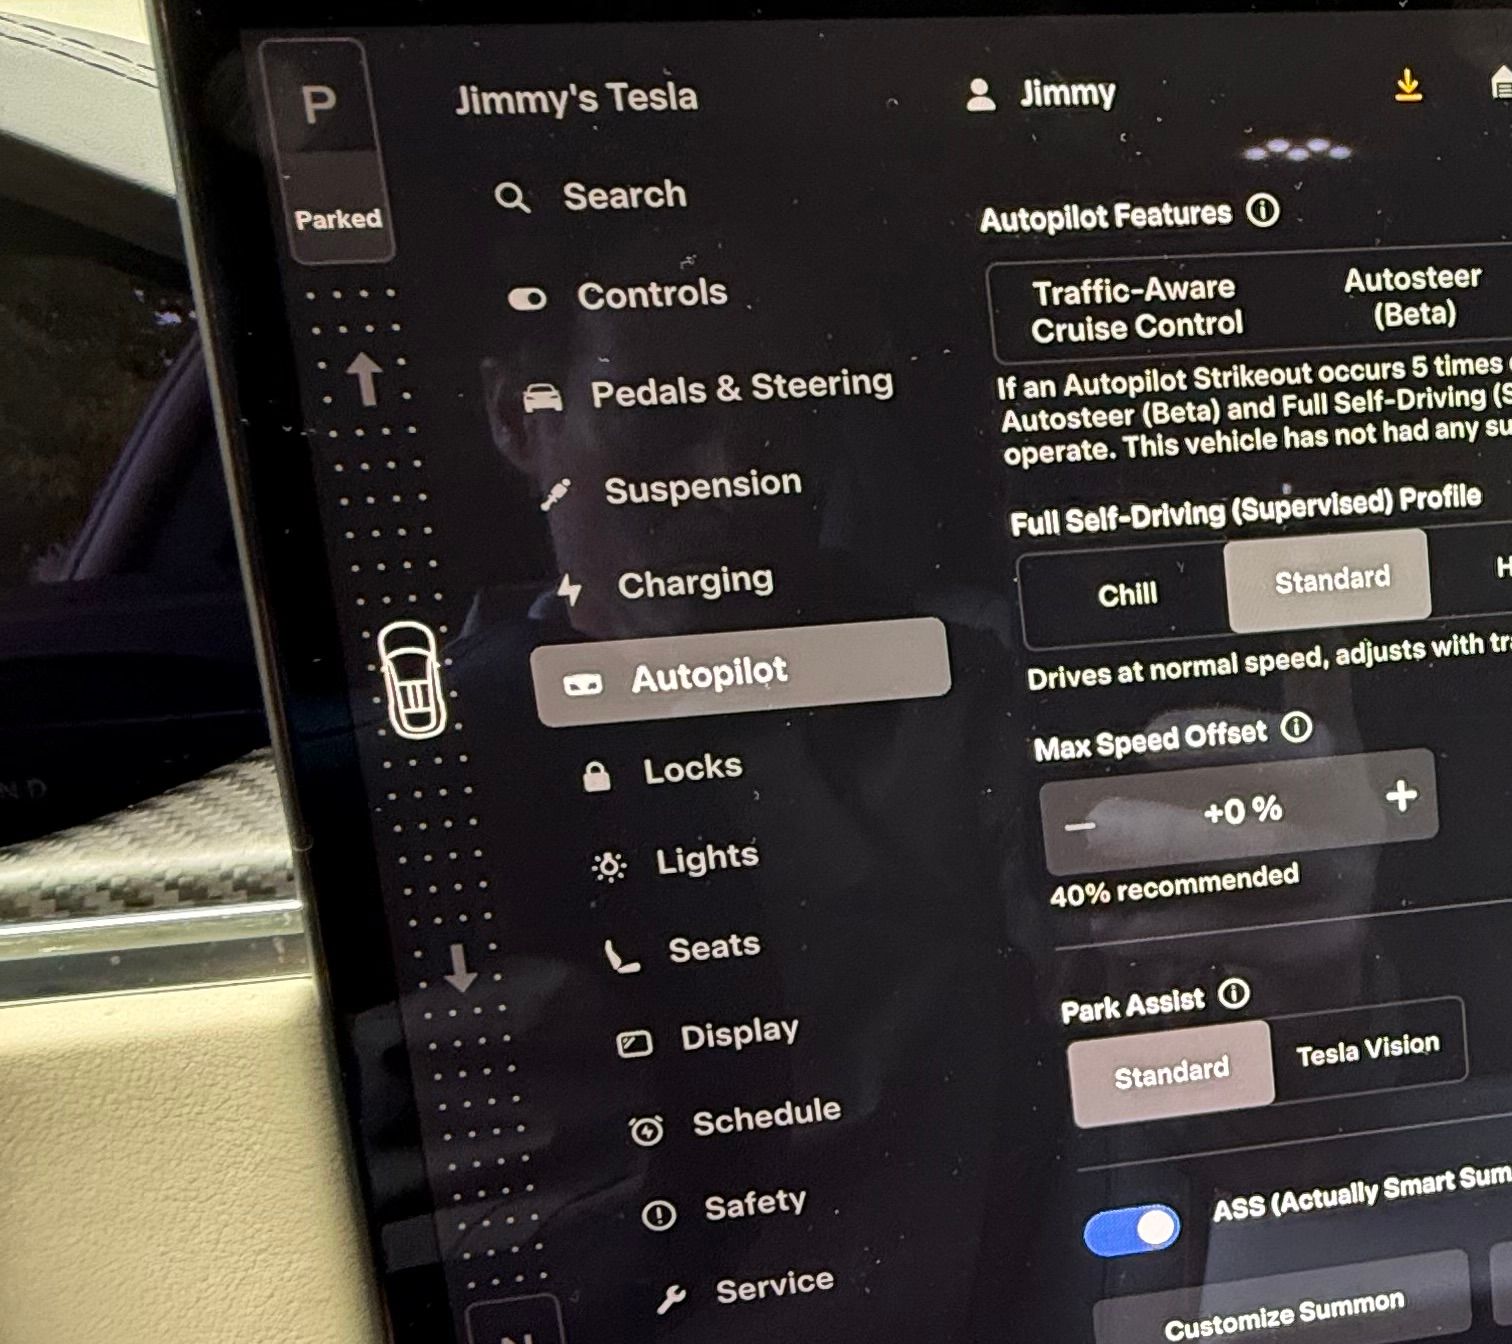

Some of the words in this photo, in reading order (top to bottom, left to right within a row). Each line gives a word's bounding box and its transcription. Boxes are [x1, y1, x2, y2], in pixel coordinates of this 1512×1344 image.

[301, 85, 337, 124] P
[455, 83, 599, 120] Jimmy's
[604, 81, 699, 112] Tesla
[1020, 78, 1116, 111] Jimmy
[563, 178, 687, 211] Search
[294, 208, 383, 231] Parked
[980, 203, 1110, 236] Autopilot
[1113, 202, 1233, 228] Features
[577, 277, 728, 311] Controls
[1031, 276, 1236, 306] Traffic-Aware
[1344, 266, 1483, 293] Autosteer
[1031, 315, 1128, 344] Cruise
[1134, 308, 1244, 339] Control
[1374, 297, 1457, 332] (Beta)
[591, 376, 707, 408] Pedals
[716, 374, 743, 402] &
[751, 368, 894, 400] Steering
[997, 375, 1017, 400] If
[1023, 379, 1057, 399] an
[1063, 368, 1188, 399] Autopilot
[1193, 362, 1314, 390] Strikeout
[1317, 361, 1406, 384] occurs
[1412, 355, 1429, 378] 5
[1433, 353, 1504, 377] times
[1001, 407, 1136, 433] Autosteer
[1142, 397, 1220, 429] (Beta)
[1227, 394, 1276, 421] and
[1282, 392, 1328, 417] Full
[1334, 385, 1487, 414] Self-Driving
[1003, 439, 1117, 470] operate.
[1121, 432, 1180, 459] This
[1183, 427, 1278, 455] vehicle
[1283, 425, 1329, 449] has
[1334, 422, 1377, 446] not
[1382, 417, 1430, 443] had
[1434, 420, 1480, 443] any
[604, 469, 802, 507] Suspension
[1010, 508, 1061, 537] Full
[1065, 500, 1226, 533] Self-Driving
[1231, 484, 1394, 526] (Supervised)
[1399, 482, 1482, 512] Profile
[618, 565, 774, 600] Charging
[1098, 580, 1158, 608] Chill
[1275, 564, 1391, 595] Standard
[631, 657, 789, 697] Autopilot
[1027, 665, 1112, 691] Drives
[1117, 661, 1145, 684] at
[1149, 651, 1239, 681] normal
[1244, 644, 1330, 677] speed,
[1335, 639, 1427, 669] adjusts
[1430, 632, 1485, 658] with
[1033, 736, 1093, 762] Max
[1096, 725, 1180, 760] Speed
[1184, 719, 1269, 748] Offset
[644, 753, 743, 785] Locks
[1203, 798, 1246, 825] +0
[1251, 794, 1283, 823] %
[656, 844, 760, 878] Lights
[1049, 881, 1111, 908] 40%
[1116, 861, 1300, 902] recommended
[669, 934, 761, 963] Seats
[1061, 995, 1121, 1025] Park
[1125, 987, 1206, 1017] Assist
[681, 1017, 799, 1051] Display
[1295, 1041, 1360, 1067] Tesla
[1363, 1033, 1440, 1059] Vision
[1115, 1055, 1230, 1089] Standard
[693, 1097, 841, 1136] Schedule
[705, 1189, 807, 1221] Safety
[1212, 1195, 1266, 1223] ASS
[1270, 1181, 1379, 1218] (Actually
[1383, 1170, 1457, 1199] Smart
[716, 1270, 834, 1304] Service
[1164, 1307, 1296, 1342] Customize
[1298, 1291, 1405, 1323] Summon
